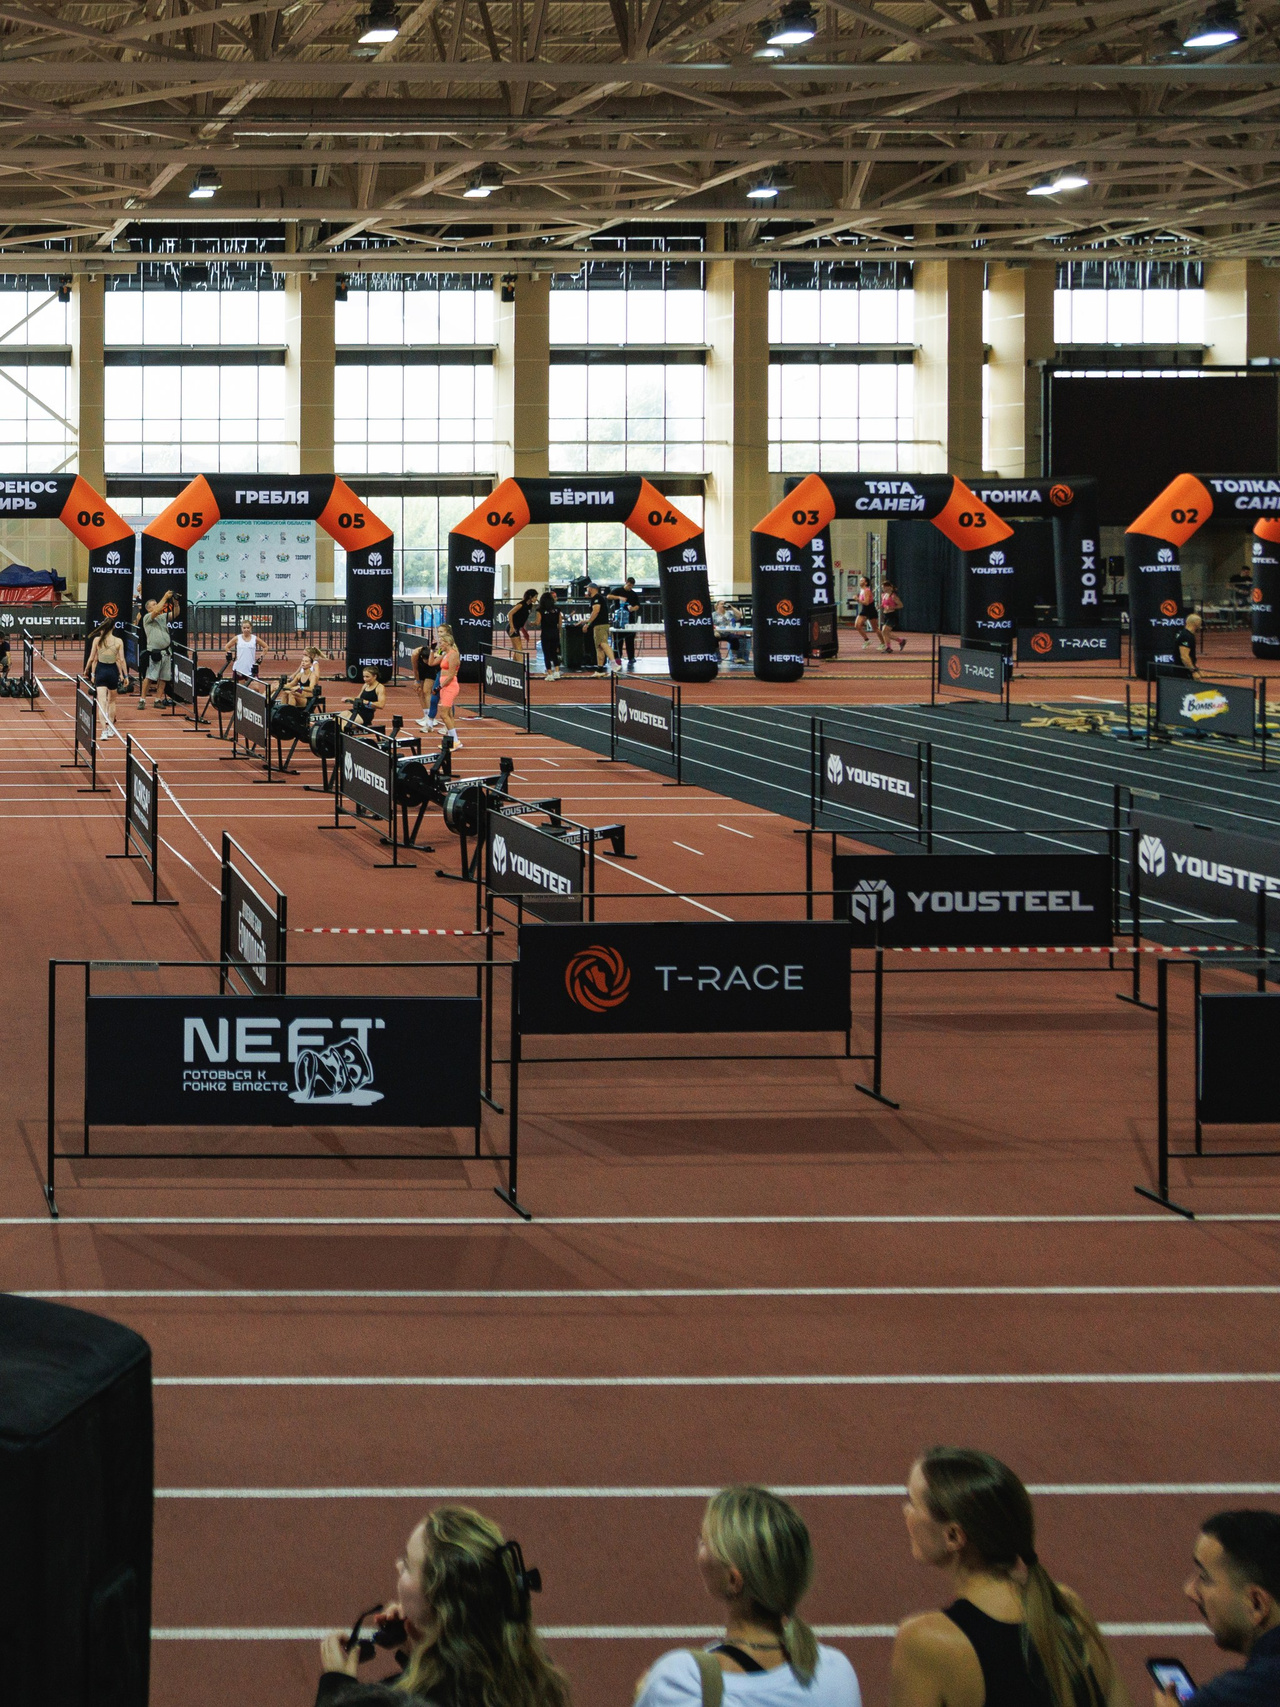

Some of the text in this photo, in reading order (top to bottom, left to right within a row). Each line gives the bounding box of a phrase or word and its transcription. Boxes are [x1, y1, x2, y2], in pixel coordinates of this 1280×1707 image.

[865, 481, 915, 494] ТЯГА
[1210, 480, 1280, 493] ТОЛКА
[235, 490, 309, 505] ГРЕБЛЯ
[550, 489, 614, 505] БЁРПИ
[855, 495, 925, 511] САНЕЙ
[981, 489, 1042, 503] ГОНКА
[1235, 497, 1280, 510] САН
[77, 510, 105, 527] 06
[176, 512, 203, 528] 05
[338, 513, 365, 529] 05
[486, 511, 516, 527] 04
[648, 511, 678, 526] 04
[792, 510, 819, 525] 03
[958, 512, 987, 527] 03
[1171, 509, 1199, 523] 02
[92, 567, 132, 575] YOUSTEEL
[146, 567, 186, 575] YOUSTEEL
[812, 539, 828, 604] ВХОД
[1081, 540, 1098, 605] ВХОД
[18, 617, 85, 626] YOUSTEEL
[357, 622, 390, 630] T-RACE
[459, 618, 492, 628] T-RACE
[678, 618, 712, 627] T-RACE
[766, 617, 801, 626] T-RACE
[976, 620, 1012, 629] T-RACE
[1059, 638, 1107, 648] T-RACE
[964, 664, 995, 678] T-RACE
[493, 672, 523, 690] YOUSTEEL
[628, 708, 669, 731] YOUSTEEL
[353, 763, 389, 795] YOUSTEEL
[845, 765, 915, 799] YOUSTEEL
[908, 891, 1094, 912] YOUSTEEL
[655, 964, 804, 991] T-RACE
